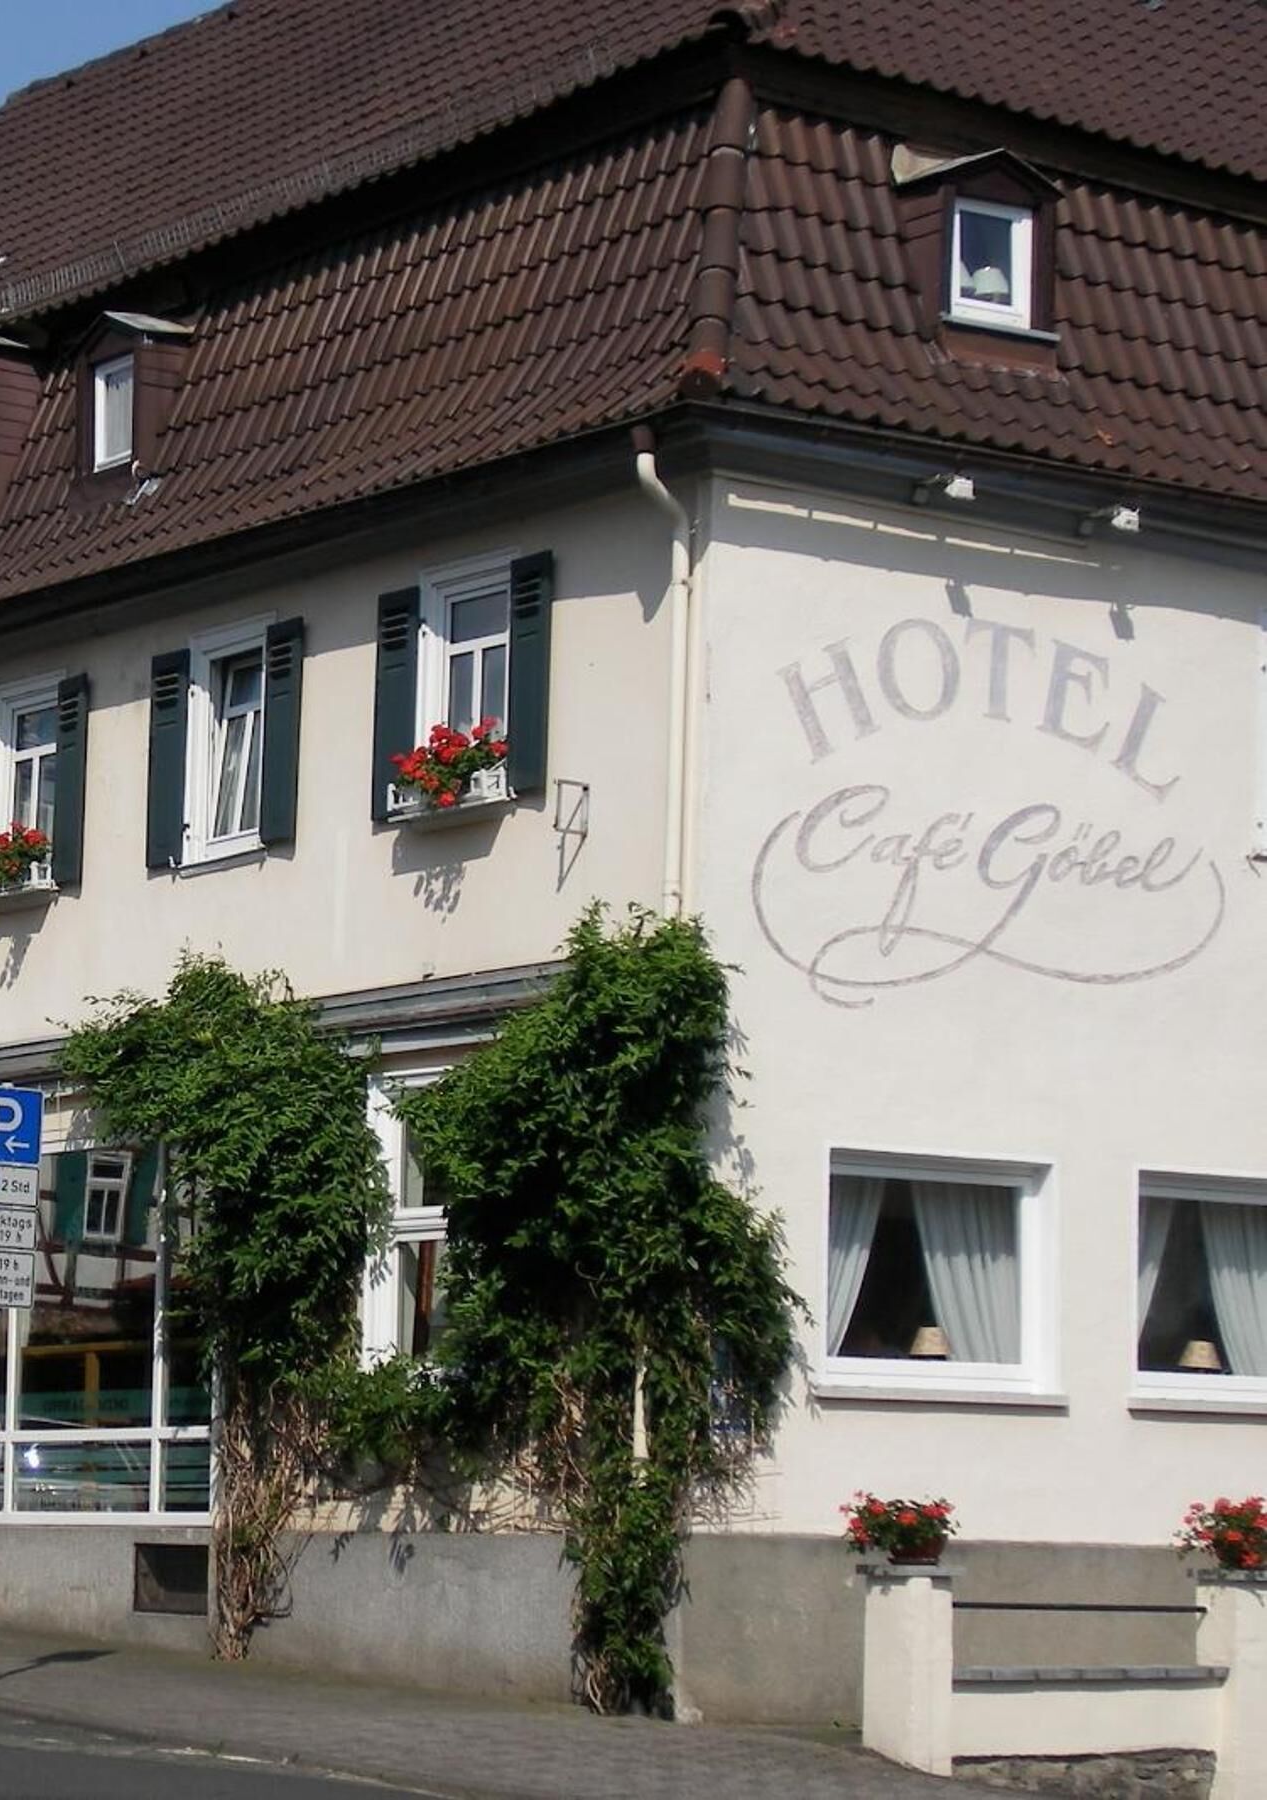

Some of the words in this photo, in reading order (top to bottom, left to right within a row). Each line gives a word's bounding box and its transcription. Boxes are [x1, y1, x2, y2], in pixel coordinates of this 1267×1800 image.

[775, 618, 1181, 802] HOTEL
[795, 785, 974, 956] Café
[977, 803, 1204, 925] Göbel
[1, 1179, 9, 1192] 2
[10, 1180, 31, 1194] Std
